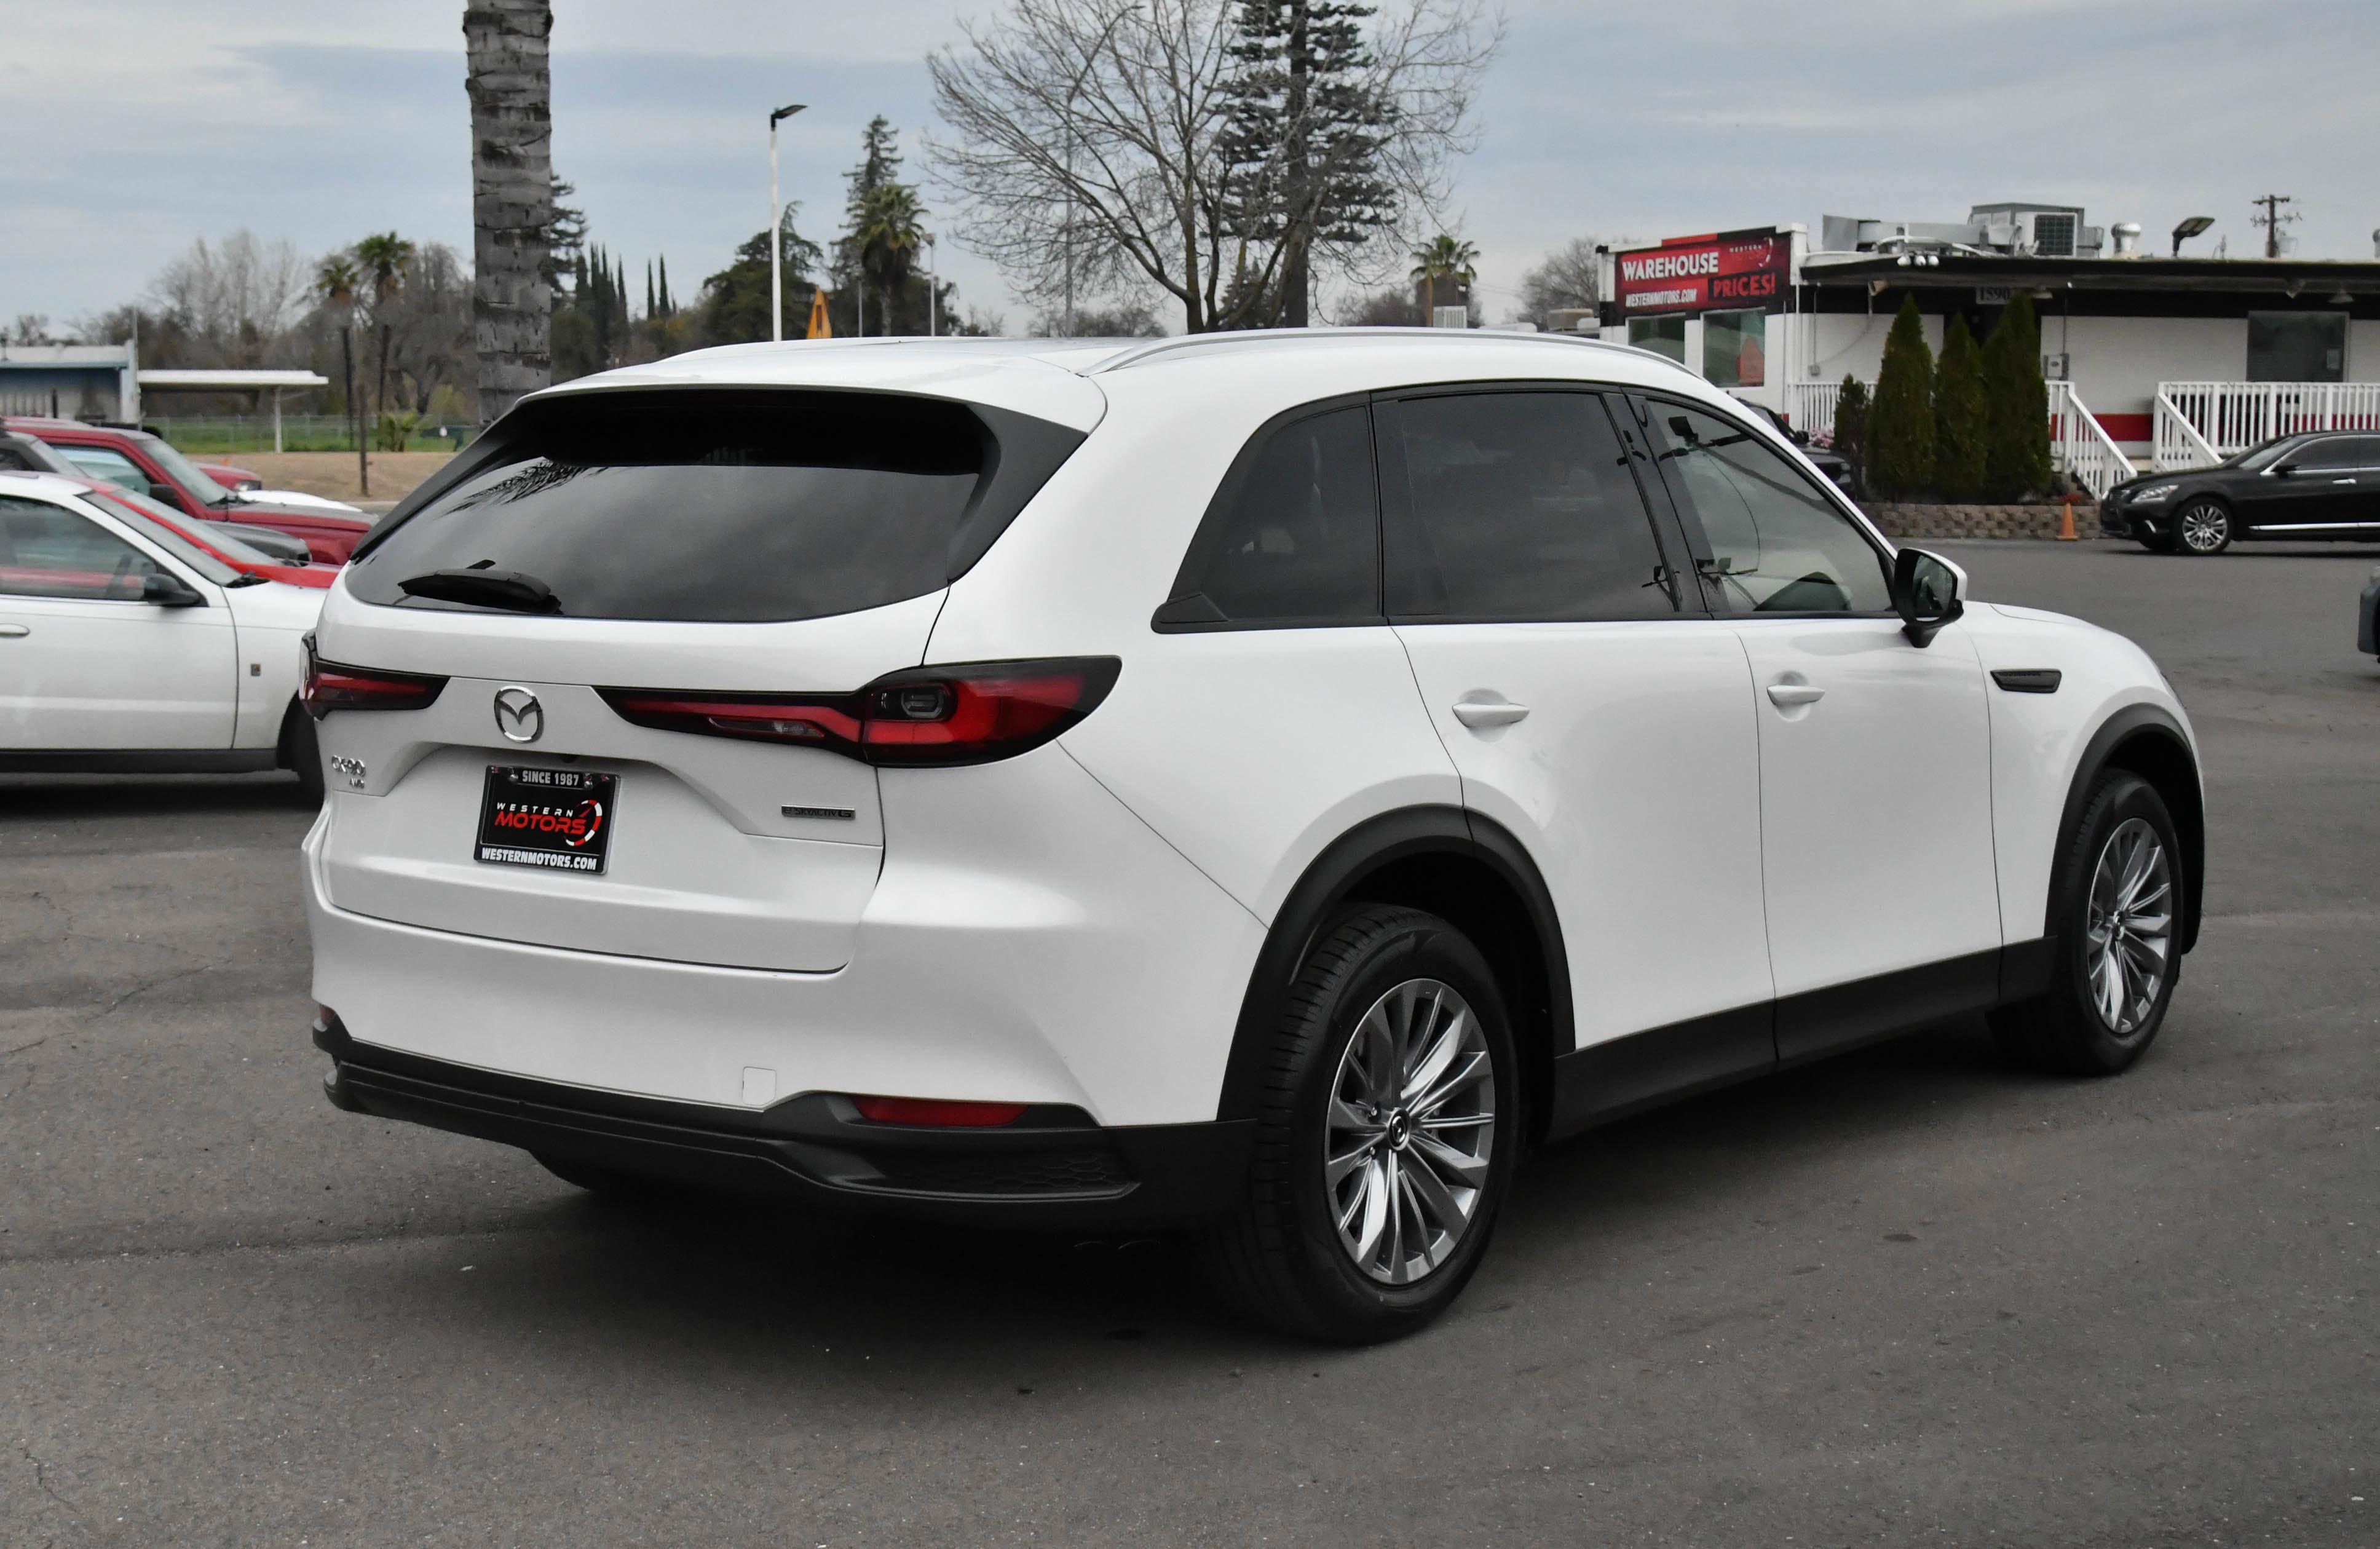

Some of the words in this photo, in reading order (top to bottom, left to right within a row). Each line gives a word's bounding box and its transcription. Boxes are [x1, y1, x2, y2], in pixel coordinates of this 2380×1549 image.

[1622, 252, 1719, 282] WAREHOUSE
[1714, 272, 1776, 298] PRICES!
[1625, 288, 1698, 307] WESTERNMOTORS.COM
[522, 771, 551, 784] SINCE
[555, 773, 579, 786] 1987
[497, 802, 573, 817] WESTERN
[494, 810, 587, 835] MOTORS
[481, 847, 598, 871] WESTERNMOTORS.COM
